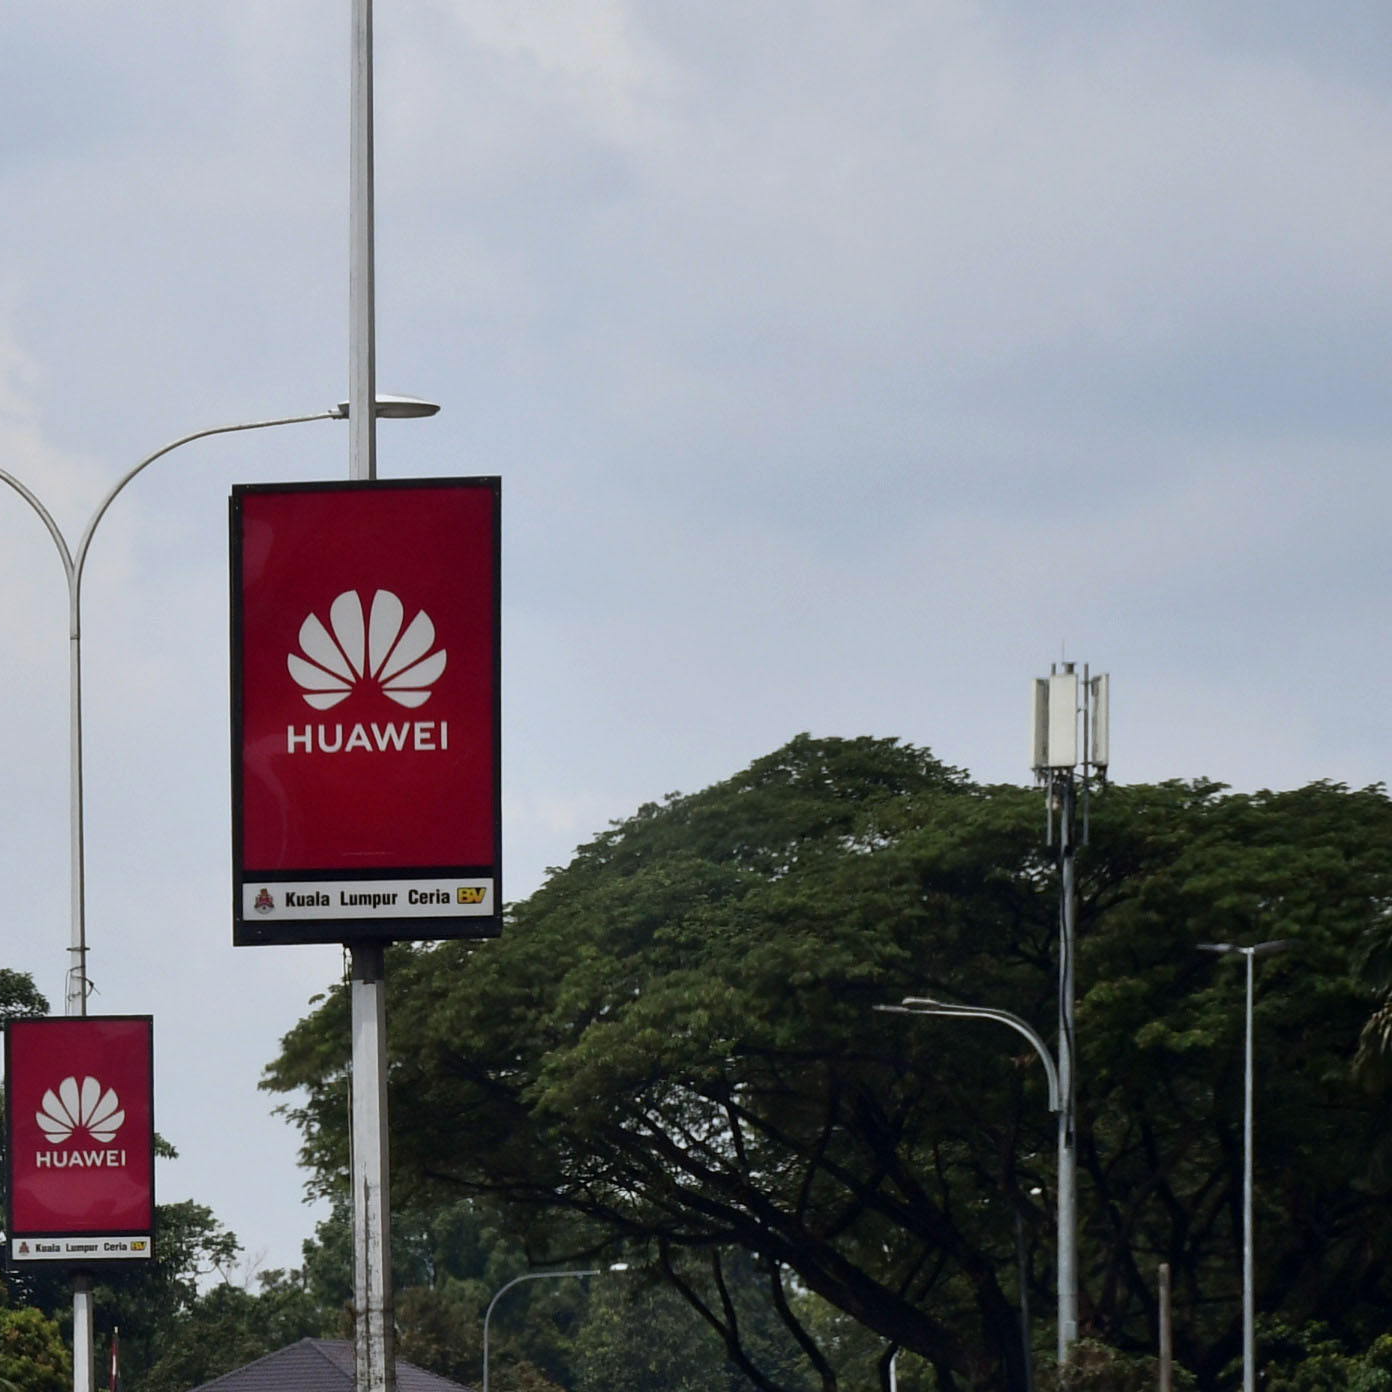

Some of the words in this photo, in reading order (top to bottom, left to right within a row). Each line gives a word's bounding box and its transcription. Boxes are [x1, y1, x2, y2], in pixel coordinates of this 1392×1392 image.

[287, 720, 449, 754] HUAWEI
[285, 890, 330, 908] Kuala
[340, 889, 398, 909] Lumpur
[408, 888, 450, 905] Ceria
[36, 1150, 126, 1168] HUAWEI
[35, 1243, 61, 1253] Kuala
[66, 1243, 99, 1253] Lumpur
[103, 1242, 127, 1252] Ceria
